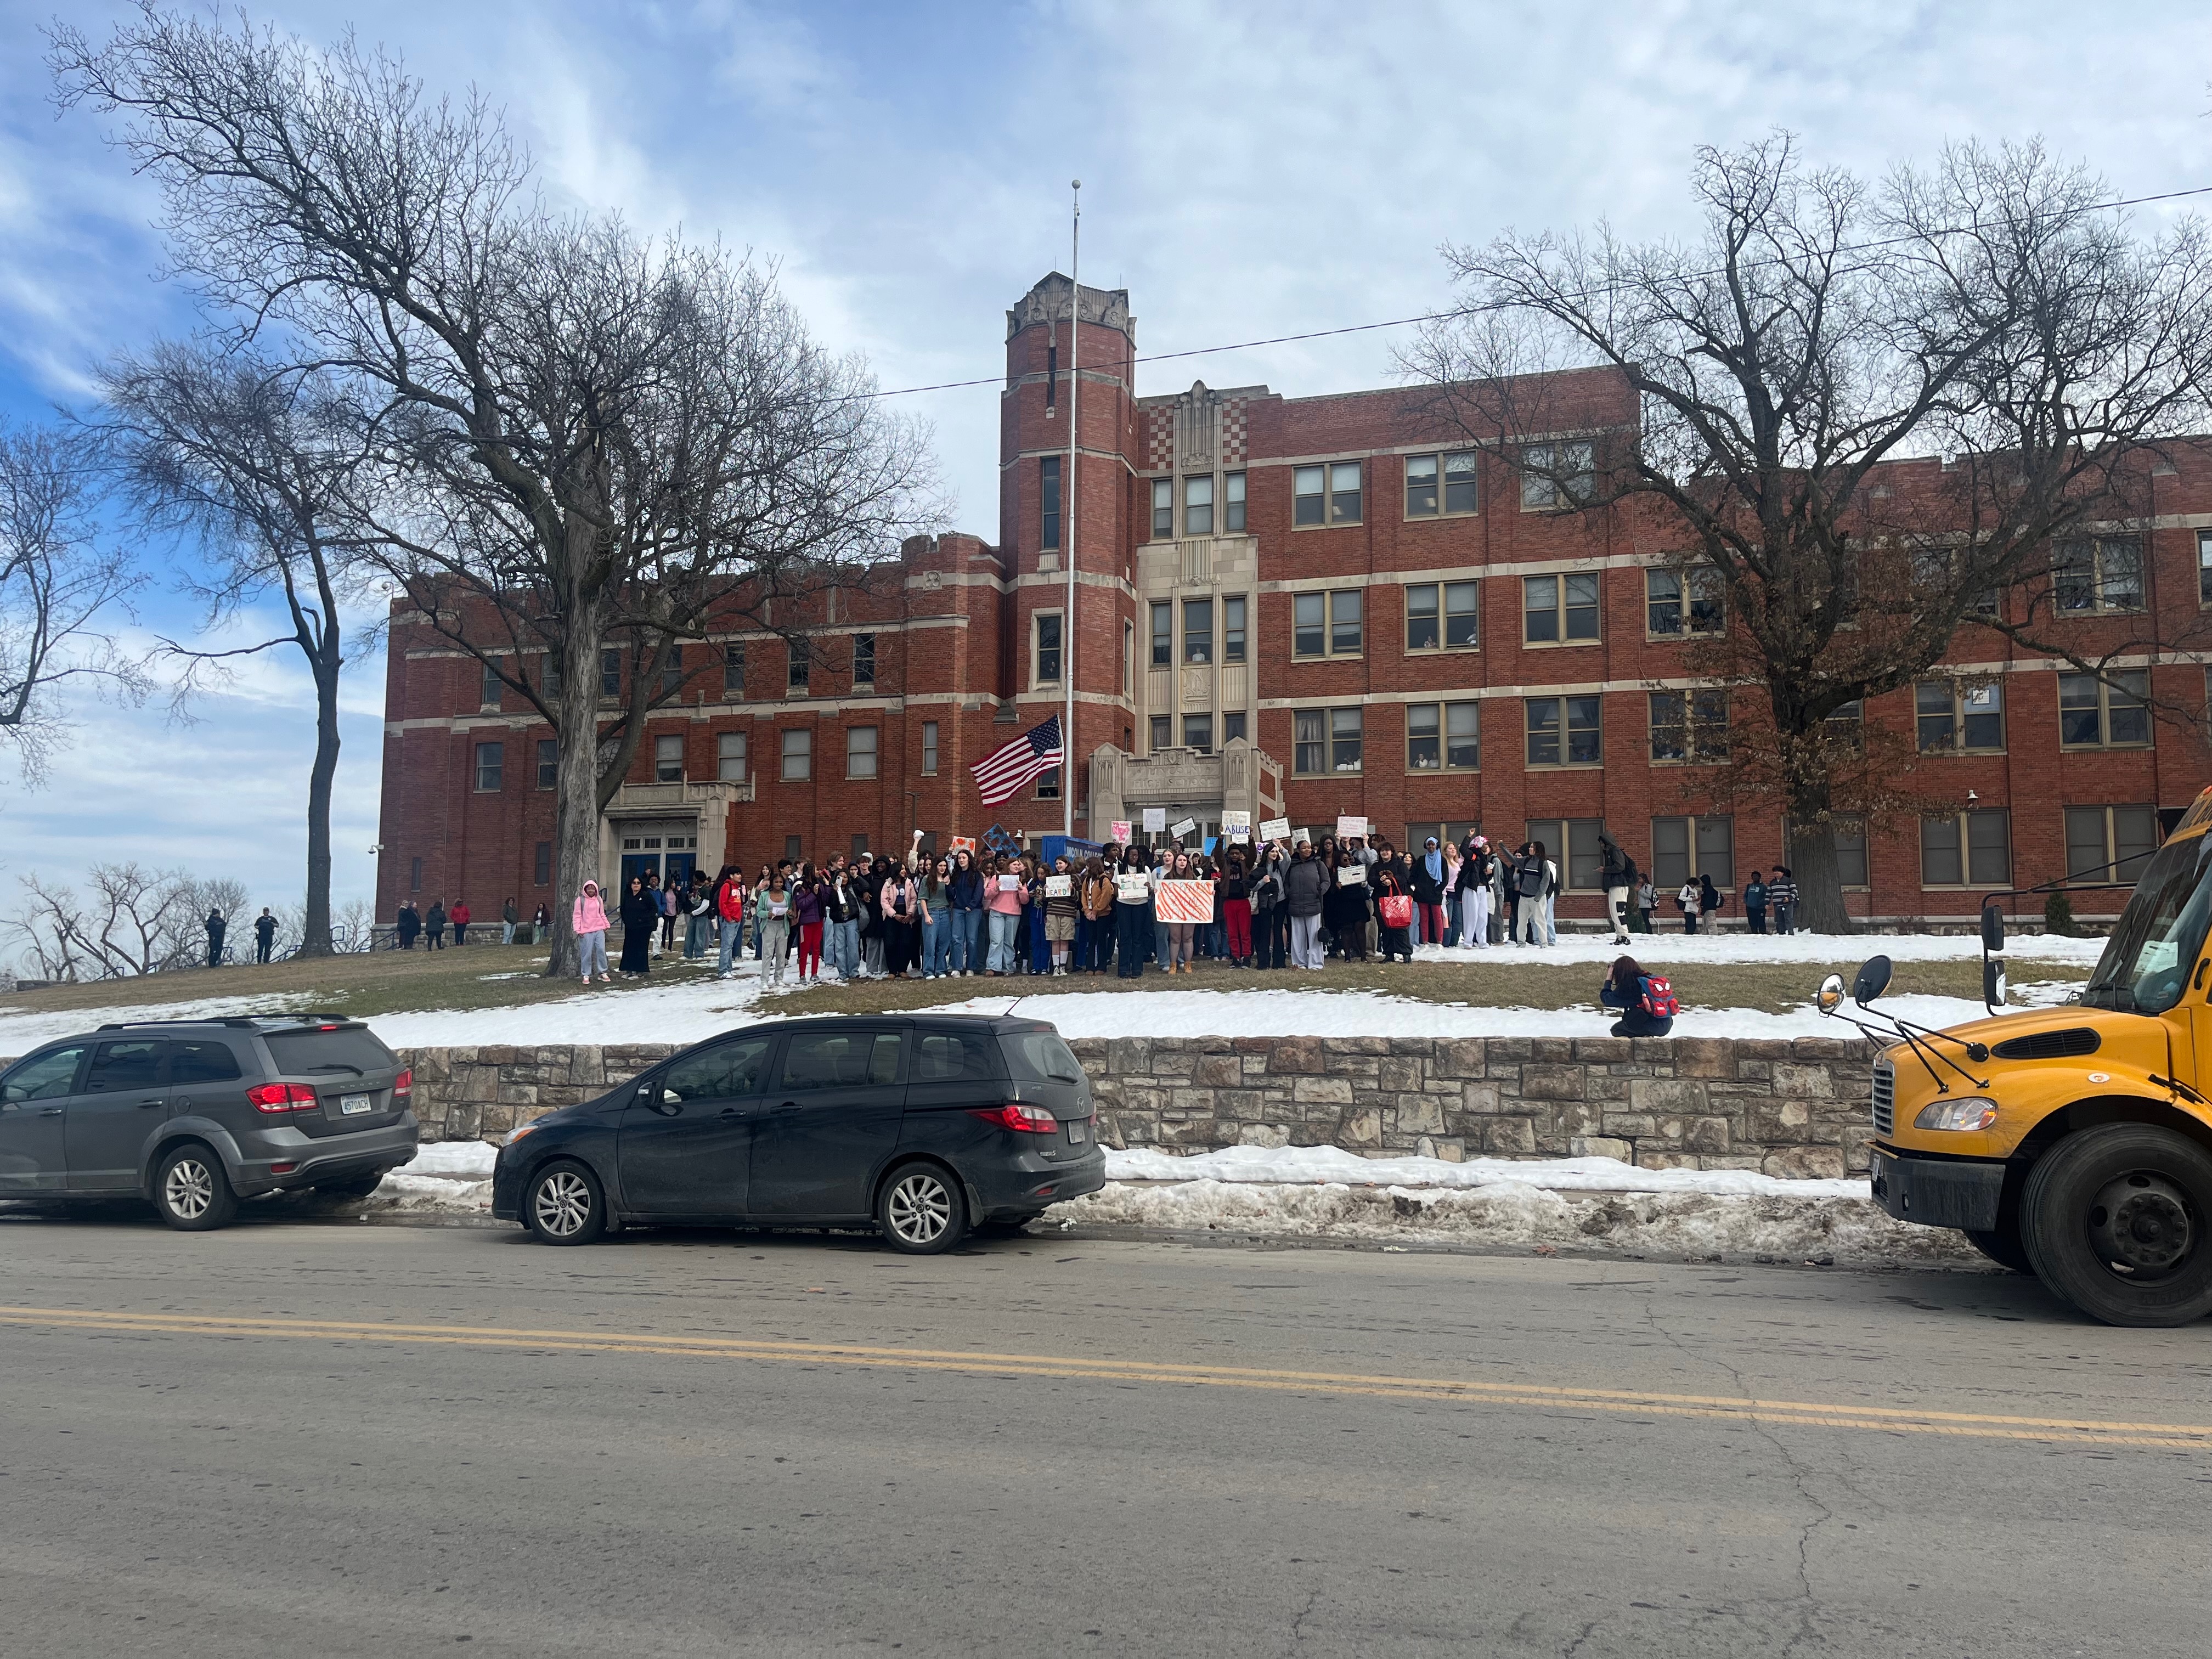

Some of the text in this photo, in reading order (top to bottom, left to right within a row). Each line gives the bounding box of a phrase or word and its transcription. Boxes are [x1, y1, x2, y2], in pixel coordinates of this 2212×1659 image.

[1148, 766, 1201, 775] LINCOLN
[1133, 778, 1214, 788] HIGH SCHOOL
[1224, 825, 1249, 834] ABUSE
